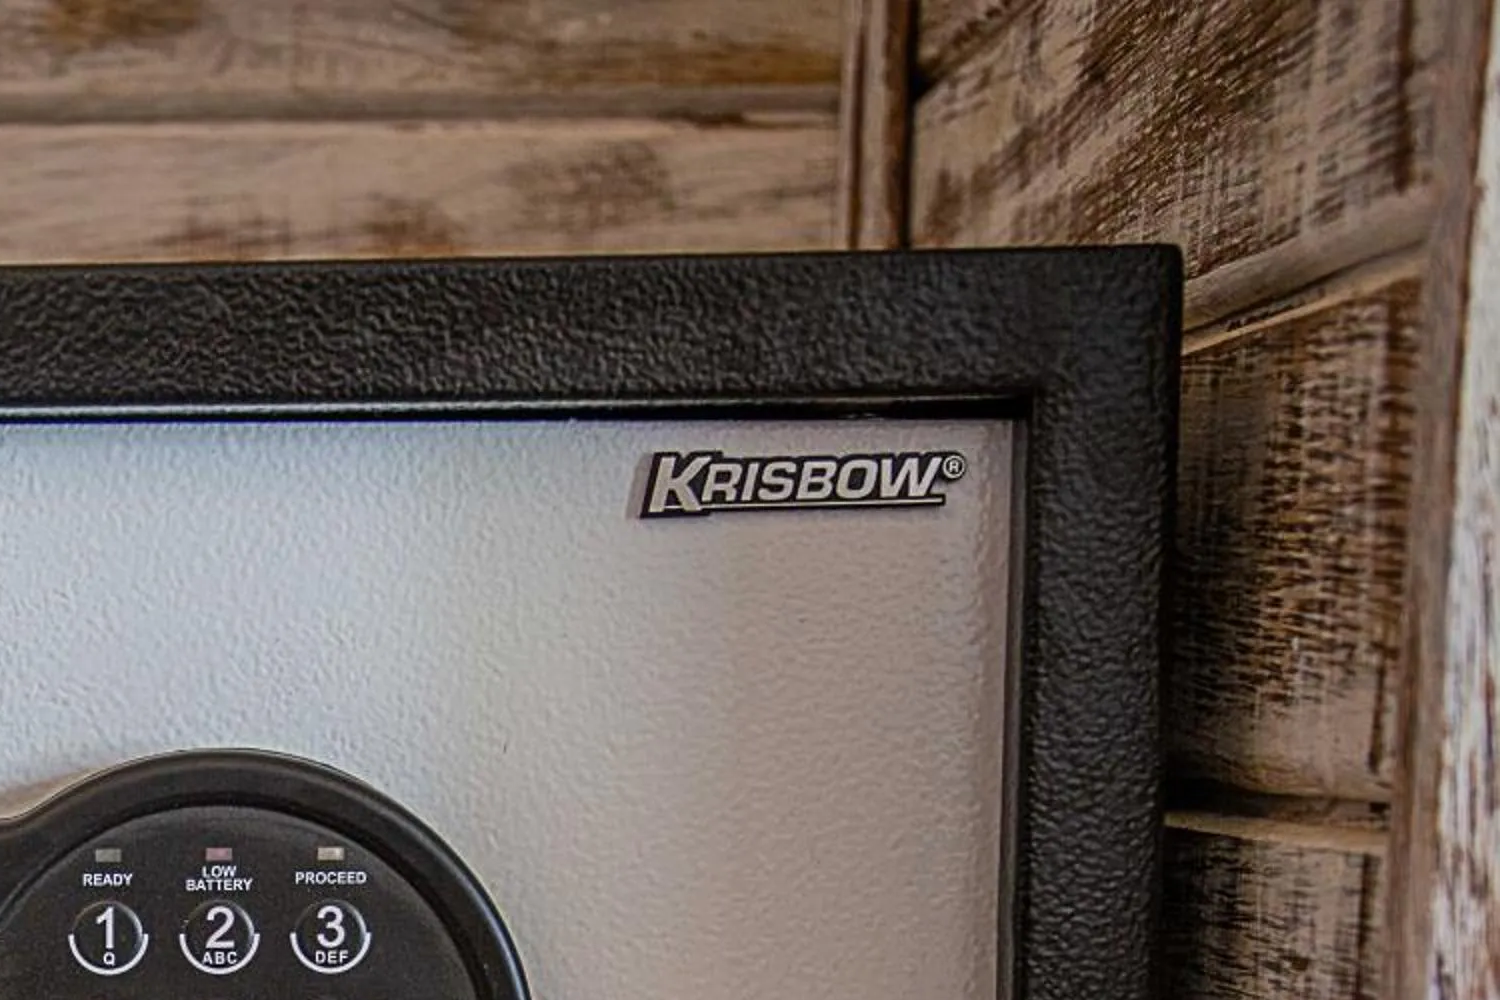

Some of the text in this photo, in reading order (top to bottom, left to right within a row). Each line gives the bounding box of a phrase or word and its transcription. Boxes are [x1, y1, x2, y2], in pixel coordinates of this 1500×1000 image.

[202, 865, 237, 878] LOW
[295, 871, 367, 885] PROCEED
[82, 873, 133, 887] READY
[185, 878, 253, 891] BATTERY
[96, 906, 114, 949] 1
[205, 906, 235, 949] 2
[316, 905, 346, 948] 3
[203, 951, 237, 965] ABC
[315, 950, 349, 964] DEF
